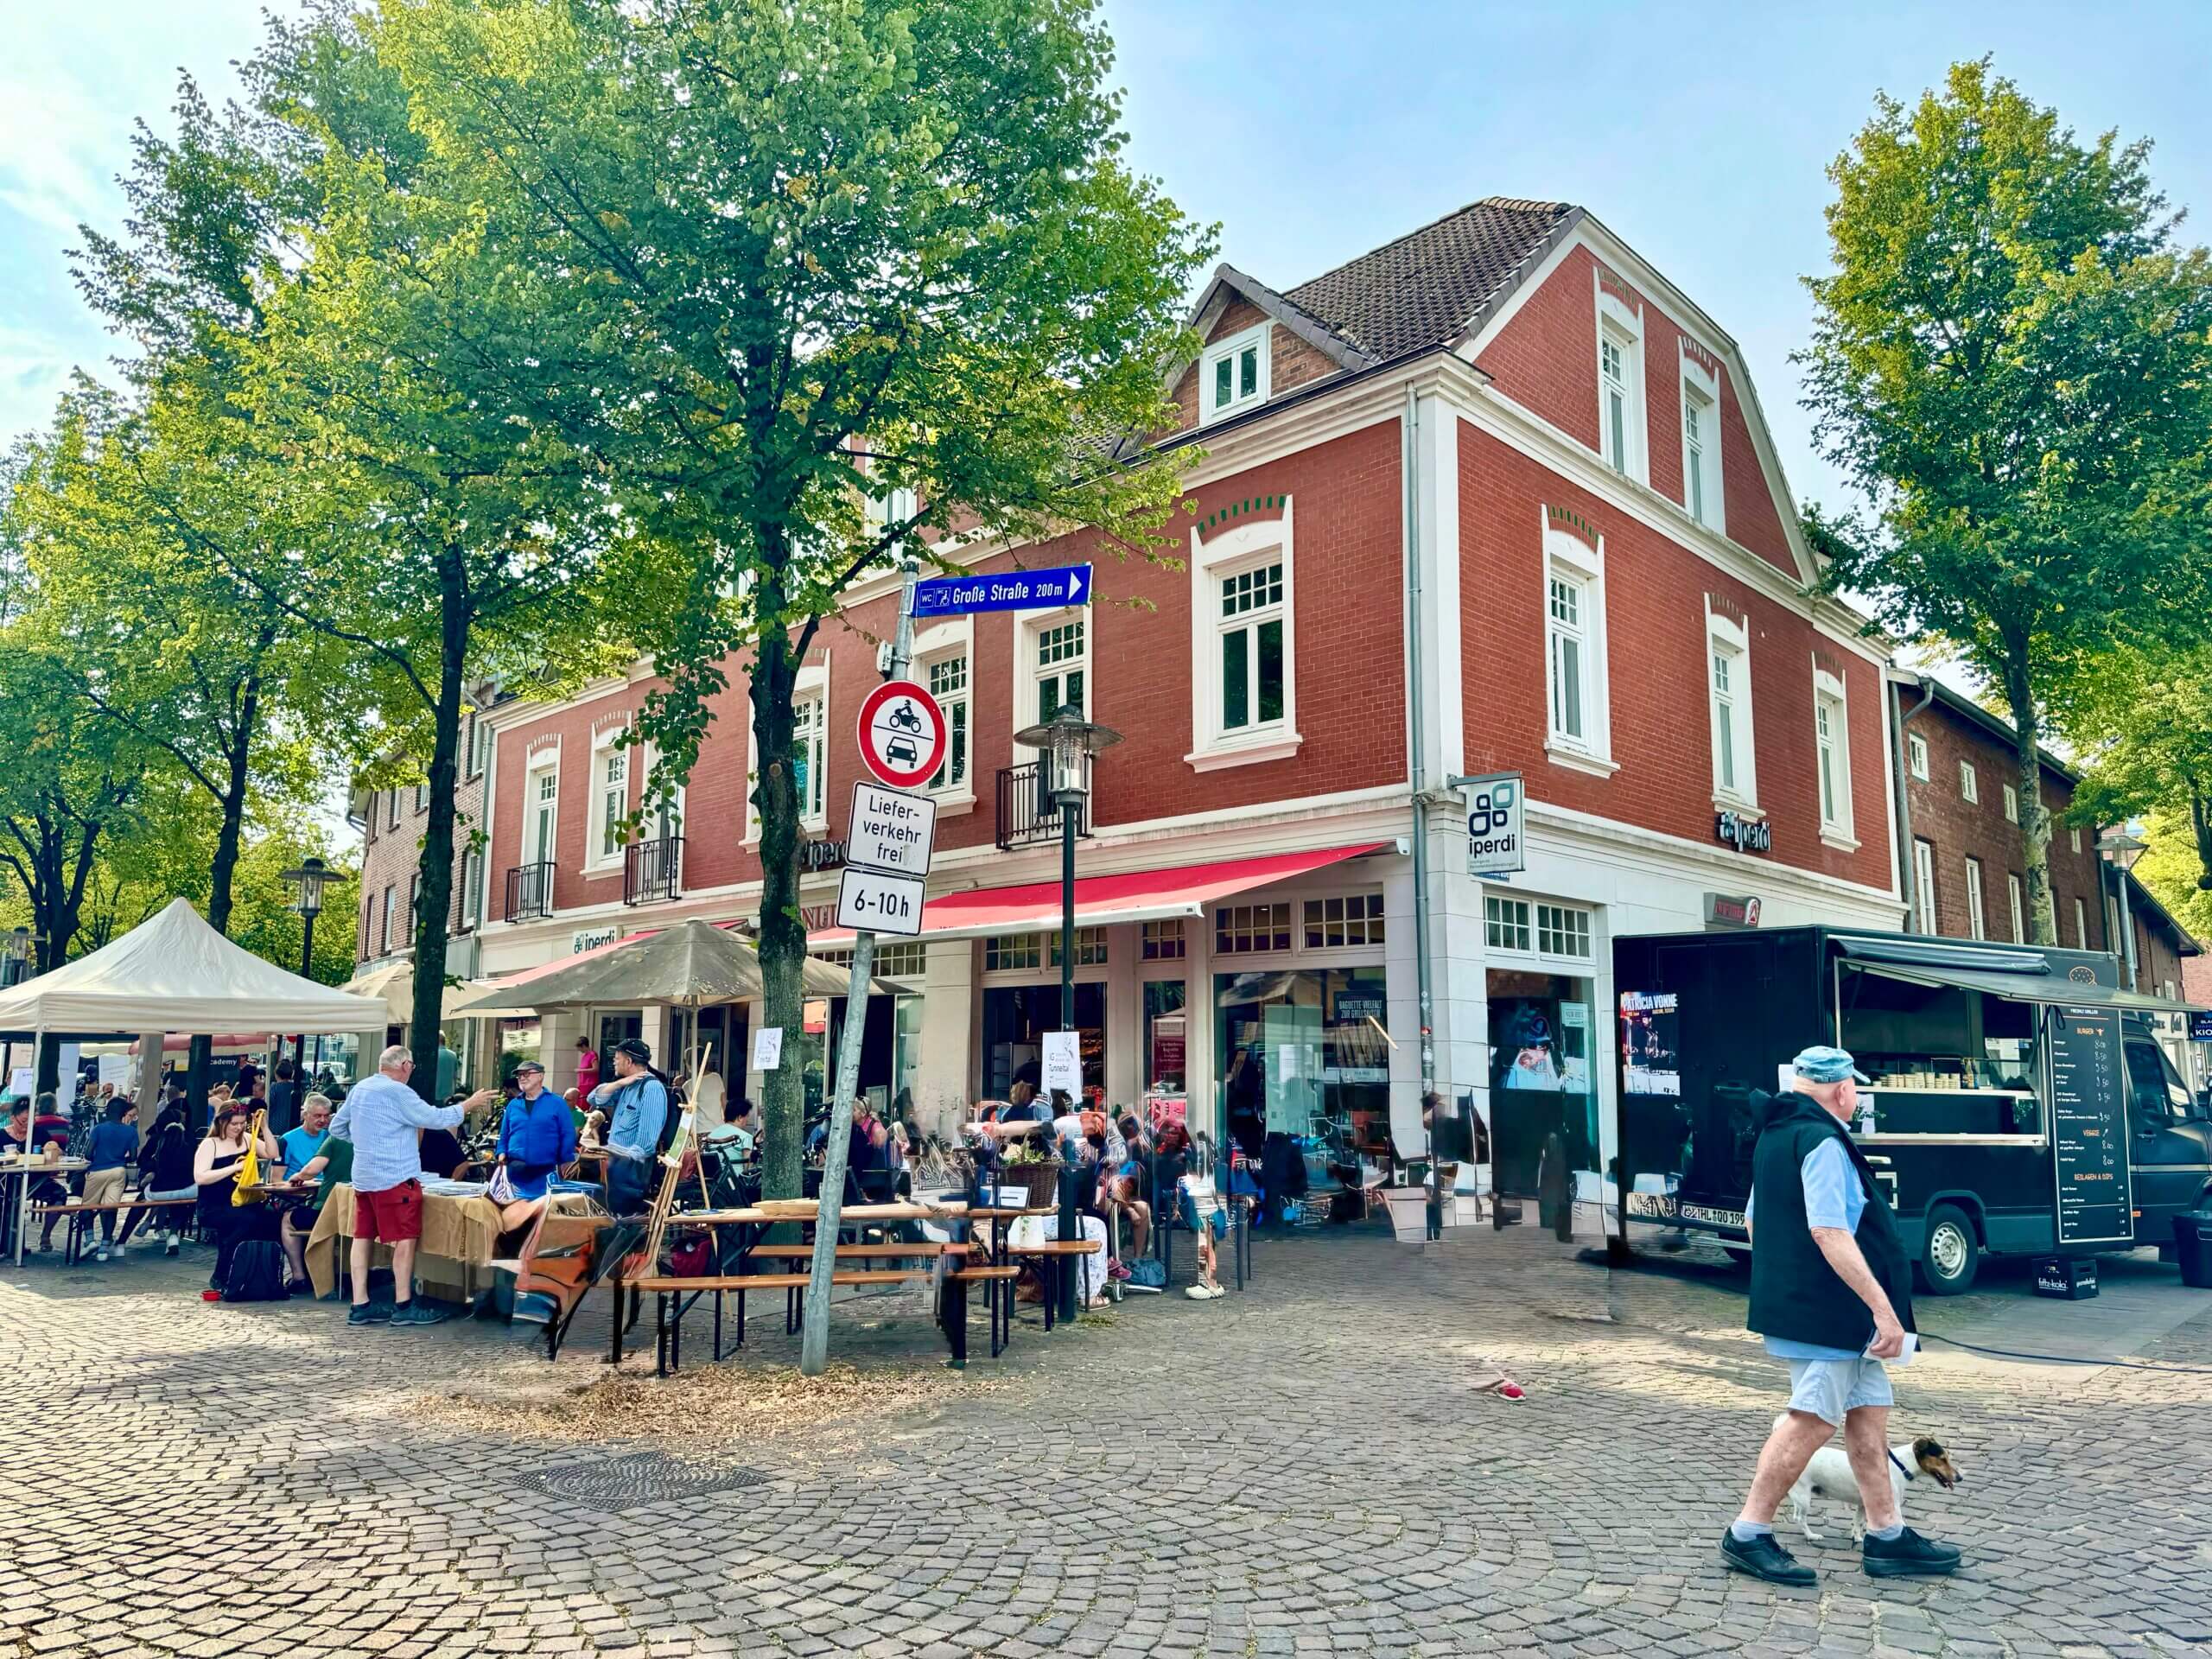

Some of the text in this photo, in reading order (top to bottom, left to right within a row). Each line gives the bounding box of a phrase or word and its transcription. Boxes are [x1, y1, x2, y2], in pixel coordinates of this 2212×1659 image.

[922, 594, 933, 602] WC
[953, 585, 986, 604] Große
[990, 582, 1029, 601] Straße
[869, 794, 920, 820] Liefer-
[863, 820, 922, 843] verkehr
[877, 842, 903, 863] frei
[1469, 834, 1516, 859] iperdi
[1624, 994, 1678, 1012] PATRICIA VONNE
[1341, 1009, 1351, 1019] ZUR
